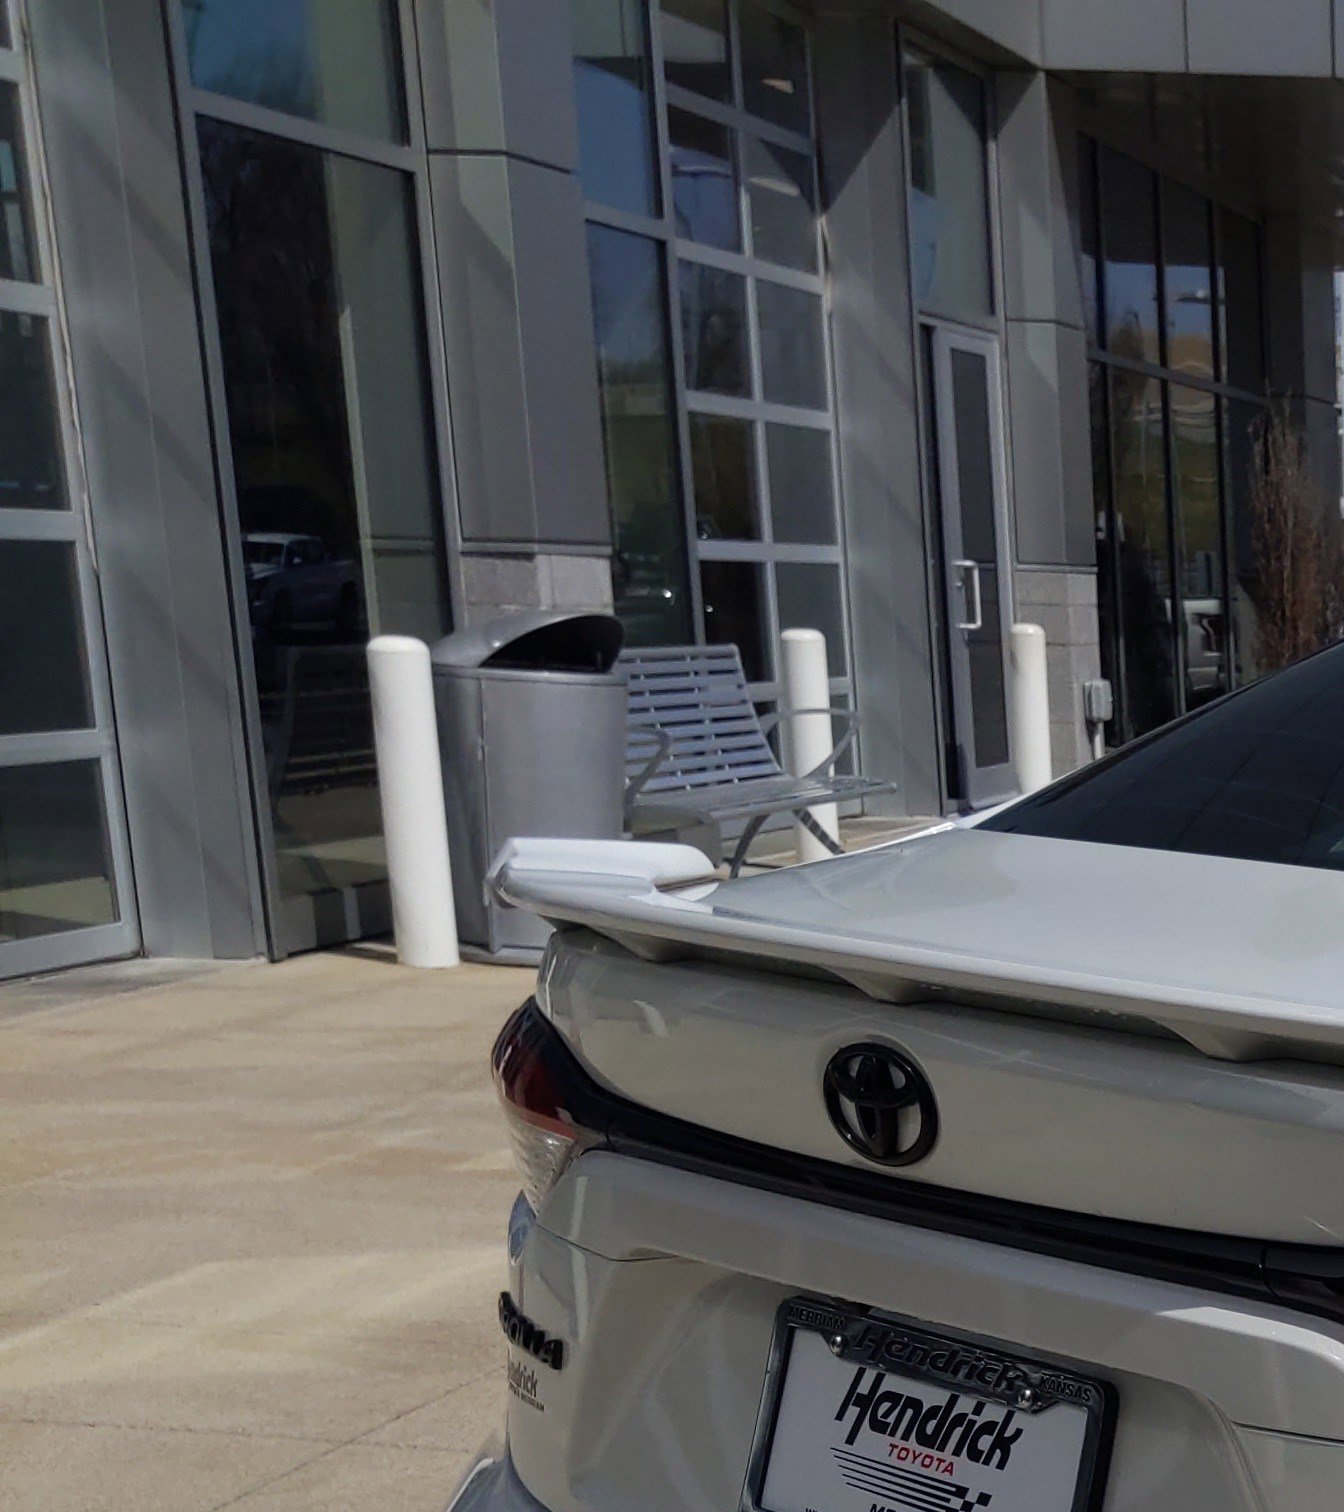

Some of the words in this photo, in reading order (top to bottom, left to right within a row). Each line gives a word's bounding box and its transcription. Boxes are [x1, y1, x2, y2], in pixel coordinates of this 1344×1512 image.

[854, 1324, 1026, 1393] Hendrick
[1039, 1371, 1092, 1403] KANSAS
[834, 1367, 1024, 1471] Hendrick
[888, 1443, 955, 1477] TOYOTA
